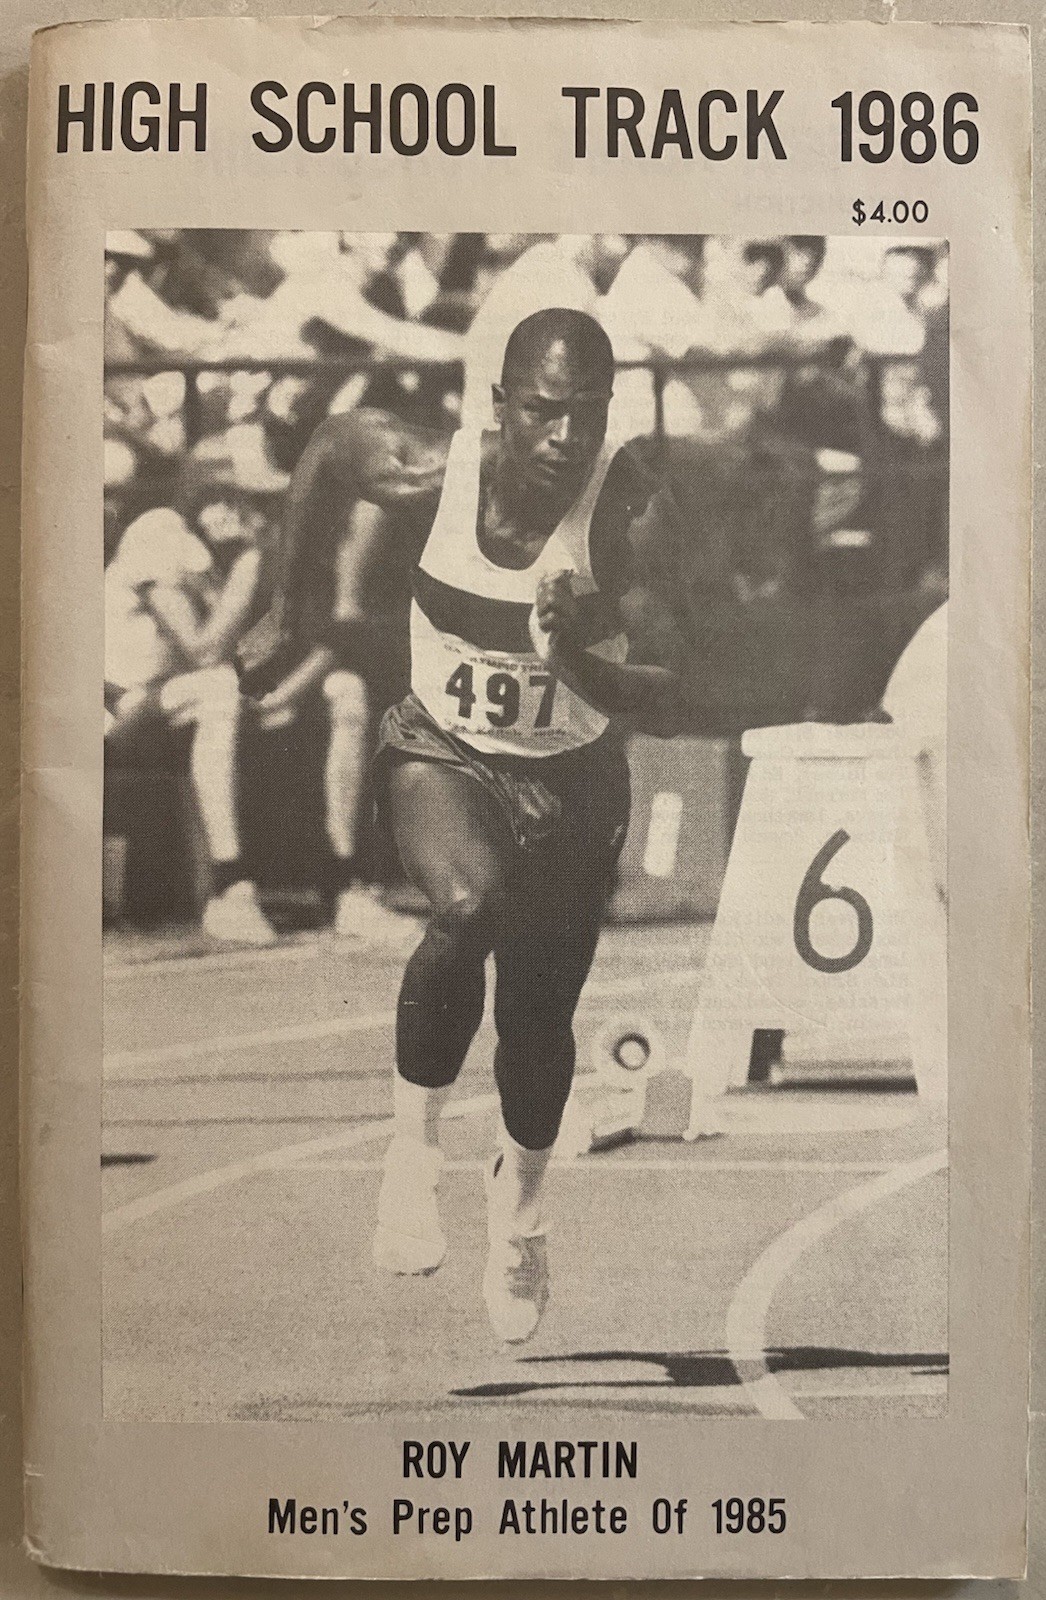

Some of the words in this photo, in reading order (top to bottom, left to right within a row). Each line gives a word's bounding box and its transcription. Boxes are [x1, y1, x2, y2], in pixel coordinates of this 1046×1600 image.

[57, 81, 207, 154] HIGH
[251, 81, 517, 157] SCHOOL
[562, 87, 788, 161] TRACK
[832, 91, 980, 165] 1986
[851, 198, 930, 227] $4.00
[445, 661, 558, 729] 497
[793, 828, 874, 974] 6
[403, 1441, 471, 1479] ROY
[498, 1442, 638, 1479] MARTIN
[268, 1498, 368, 1536] Men's
[394, 1499, 474, 1542] Prep
[498, 1498, 628, 1536] Athlete
[653, 1499, 688, 1535] Of
[712, 1498, 788, 1535] 1985
